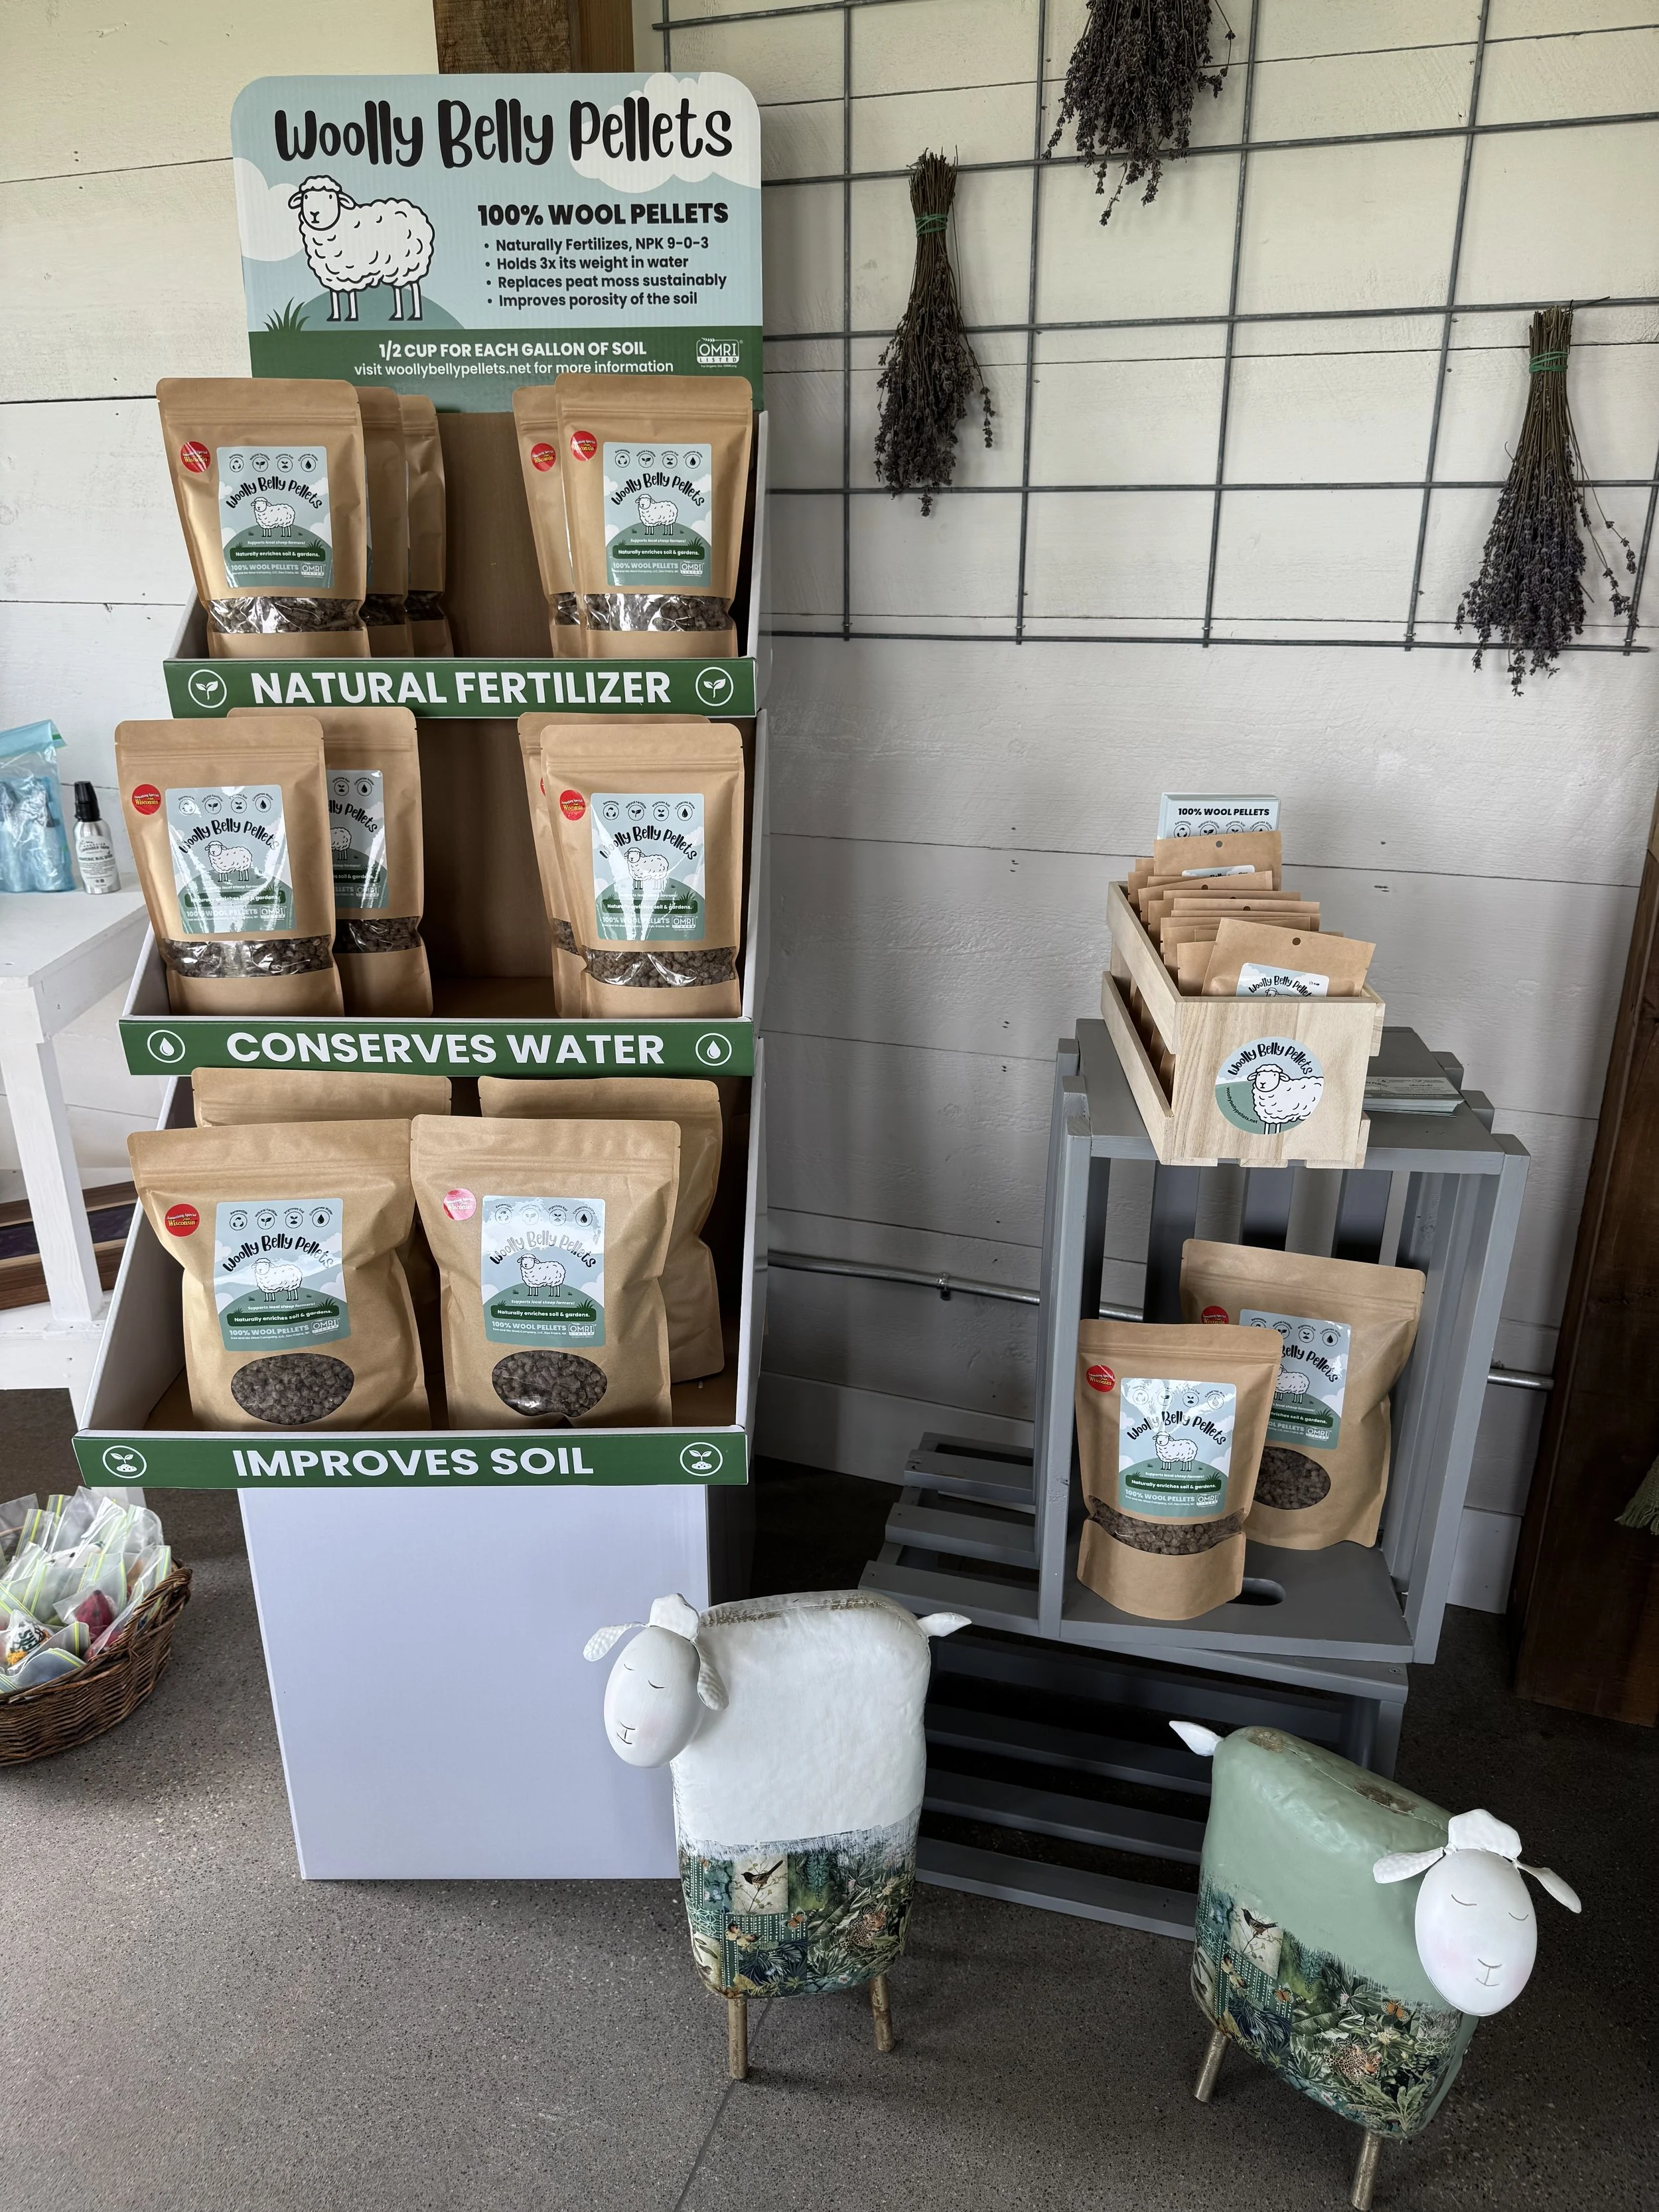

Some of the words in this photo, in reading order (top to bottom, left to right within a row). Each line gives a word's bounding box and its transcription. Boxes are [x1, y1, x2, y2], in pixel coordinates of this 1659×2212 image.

[274, 100, 423, 167] Woolly
[437, 98, 553, 169] Belly
[569, 97, 733, 163] Pellets
[478, 205, 543, 226] 100%
[547, 204, 626, 225] WOOL
[630, 203, 729, 224] PELLETS
[496, 239, 563, 254] Naturally
[566, 238, 632, 252] Fertilizes,
[636, 238, 664, 250] NPK
[668, 236, 709, 249] 9-0-3
[497, 258, 536, 269] Holds
[540, 257, 555, 269] 3x
[559, 257, 576, 268] its
[579, 256, 628, 272] weight
[632, 256, 644, 267] in
[648, 257, 688, 267] water
[498, 275, 562, 292] Replaces
[565, 276, 598, 291] peat
[601, 277, 639, 287] moss
[642, 273, 727, 289] sustainably
[499, 295, 565, 310] Improves
[569, 293, 627, 309] porosity
[630, 293, 644, 305] of
[648, 293, 670, 304] the
[673, 292, 697, 304] soil
[379, 340, 401, 360] 1/2
[404, 344, 437, 357] CUP
[440, 344, 472, 357] FOR
[474, 343, 518, 357] EACH
[522, 342, 585, 356] GALLON
[588, 342, 609, 356] OF
[612, 342, 646, 355] SOIL
[699, 344, 737, 356] OMRI
[354, 363, 382, 375] visit
[385, 362, 531, 378] woollybellypellets.net
[534, 361, 552, 374] for
[555, 364, 591, 373] more
[595, 360, 673, 373] information
[226, 482, 257, 508] Woolly
[257, 476, 286, 491] Belly
[288, 480, 322, 508] Pellets
[611, 479, 642, 505] Woolly
[643, 473, 670, 488] Belly
[672, 476, 704, 506] Pellets
[250, 670, 447, 705] NATURAL
[457, 669, 672, 704] FERTILIZER
[211, 818, 240, 835] Belly
[244, 821, 279, 850] Pellets
[632, 825, 661, 842] Belly
[663, 829, 697, 859] Pellets
[1248, 978, 1271, 993] Woolly
[1274, 976, 1293, 986] Belly
[1292, 981, 1312, 997] Pellet
[226, 1031, 496, 1063] CONSERVES
[506, 1034, 665, 1065] WATER
[1228, 1050, 1257, 1075] Woolly
[1258, 1042, 1285, 1057] Belly
[1285, 1046, 1313, 1074] Pellets
[1226, 1087, 1258, 1124] woollybellypellets.net
[222, 1242, 259, 1272] Woolly
[261, 1233, 293, 1252] Belly
[295, 1236, 334, 1268] Pellets
[490, 1236, 524, 1264] Woolly
[526, 1230, 557, 1247] Belly
[559, 1235, 596, 1268] Pellets
[277, 1325, 309, 1334] PELLETS
[313, 1319, 337, 1329] OMRI
[1306, 1351, 1338, 1382] Pellets
[1127, 1416, 1159, 1440] Woolly
[1162, 1411, 1190, 1426] Belly
[1192, 1416, 1226, 1445] Pellets
[1277, 1423, 1304, 1432] PELLETS
[232, 1448, 478, 1477] IMPROVES
[492, 1448, 593, 1475] SOIL
[1125, 1489, 1143, 1498] 100%
